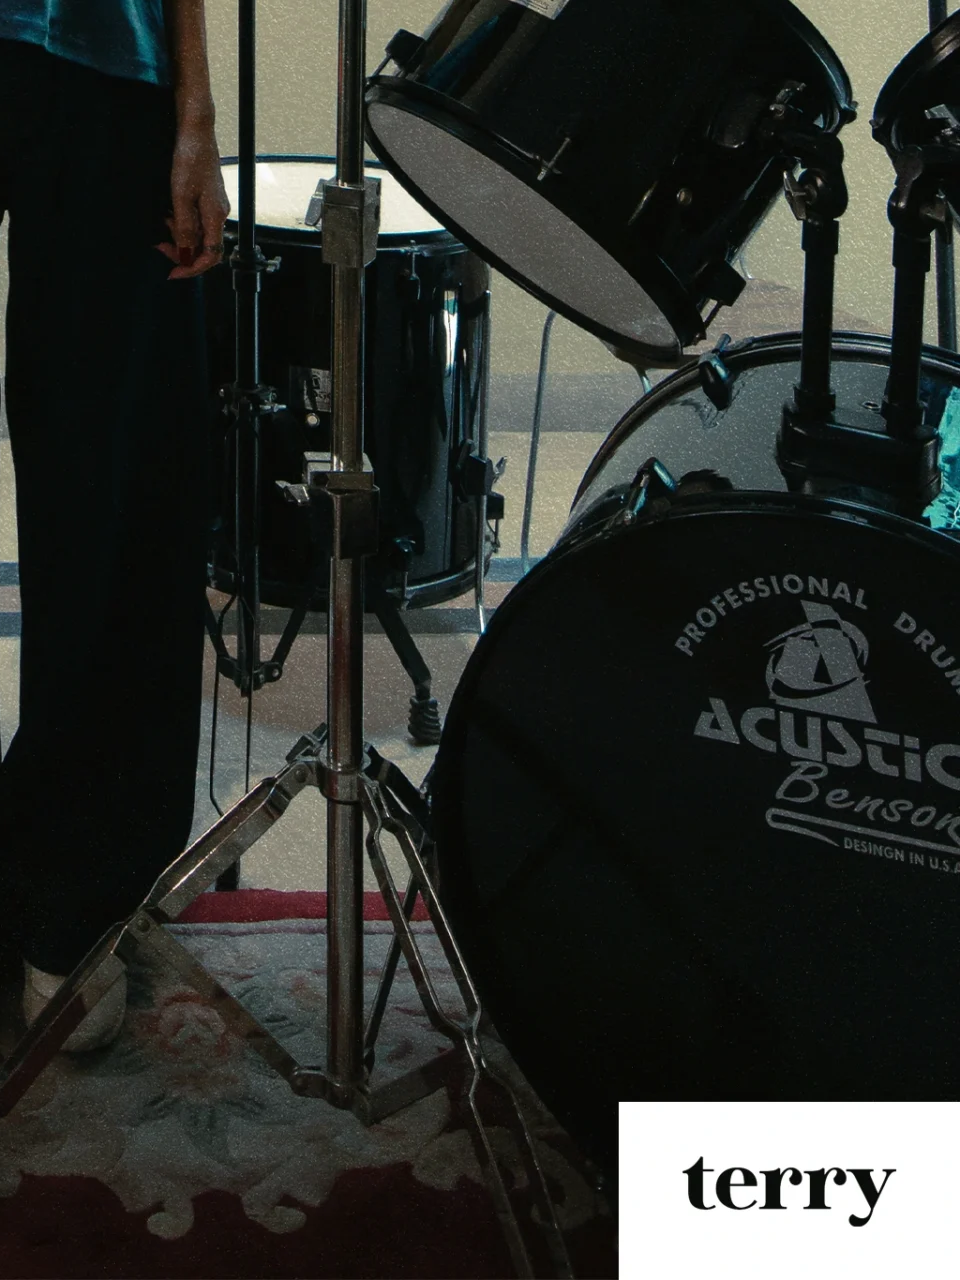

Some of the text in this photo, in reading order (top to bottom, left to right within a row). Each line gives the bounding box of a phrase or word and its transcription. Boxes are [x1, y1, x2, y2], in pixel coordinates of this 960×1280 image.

[674, 573, 869, 658] PROFESSIONAL
[843, 836, 905, 863] DESINGN
[909, 851, 925, 867] IN
